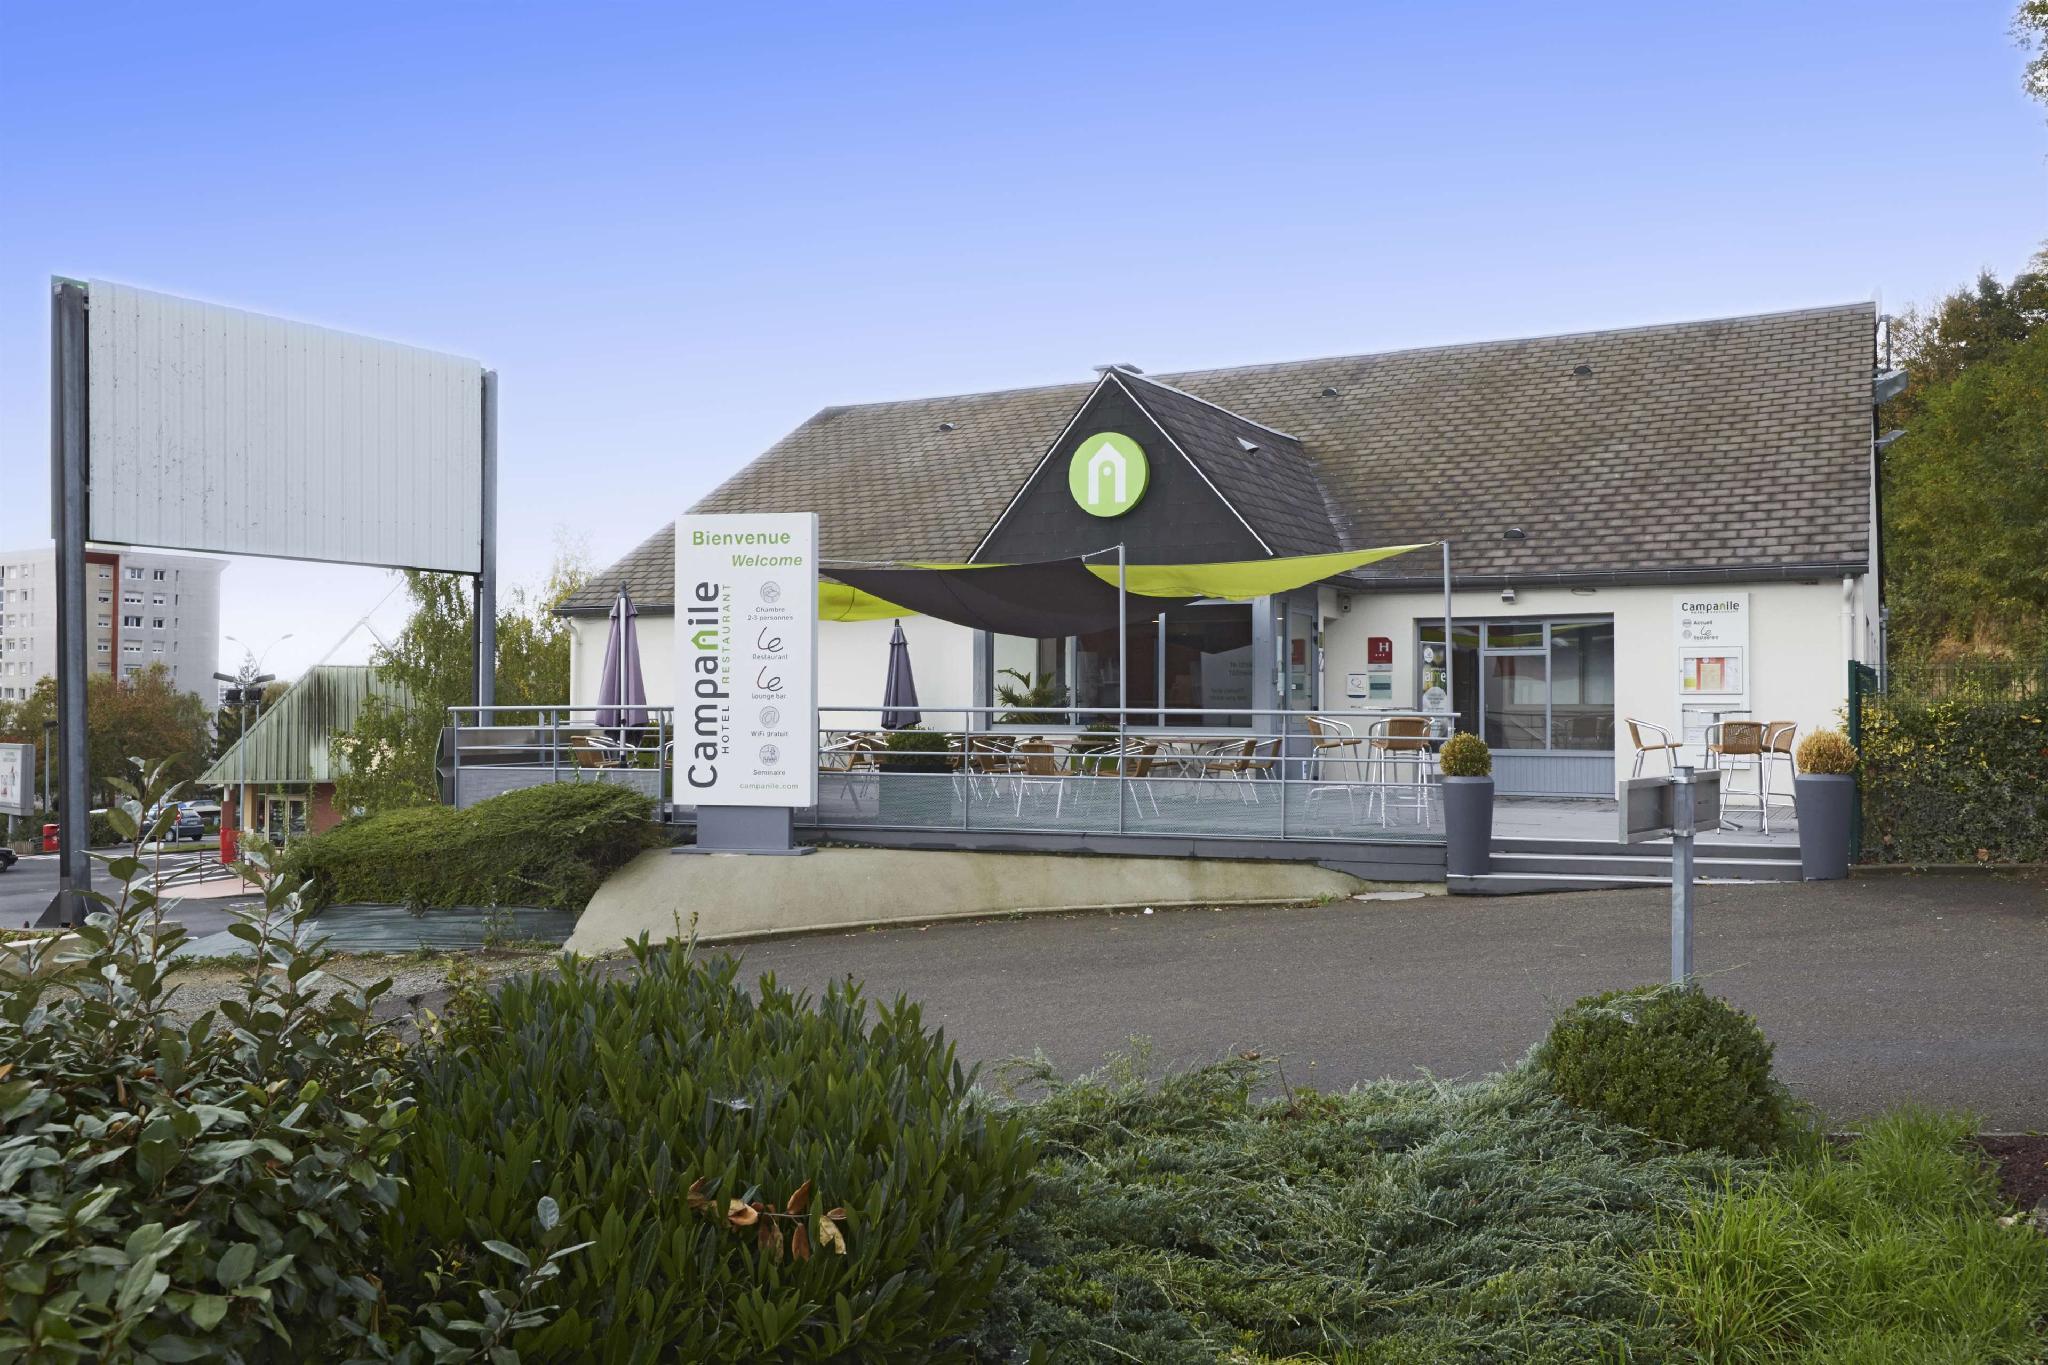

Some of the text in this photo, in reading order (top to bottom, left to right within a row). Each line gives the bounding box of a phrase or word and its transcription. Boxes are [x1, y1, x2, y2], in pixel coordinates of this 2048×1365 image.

[692, 530, 791, 546] Bienvenue
[731, 554, 803, 567] Welcome
[1681, 601, 1740, 613] Campanile
[1379, 642, 1389, 652] H
[721, 584, 732, 754] HOTEL RESTAURANT
[687, 581, 730, 788] Campanile
